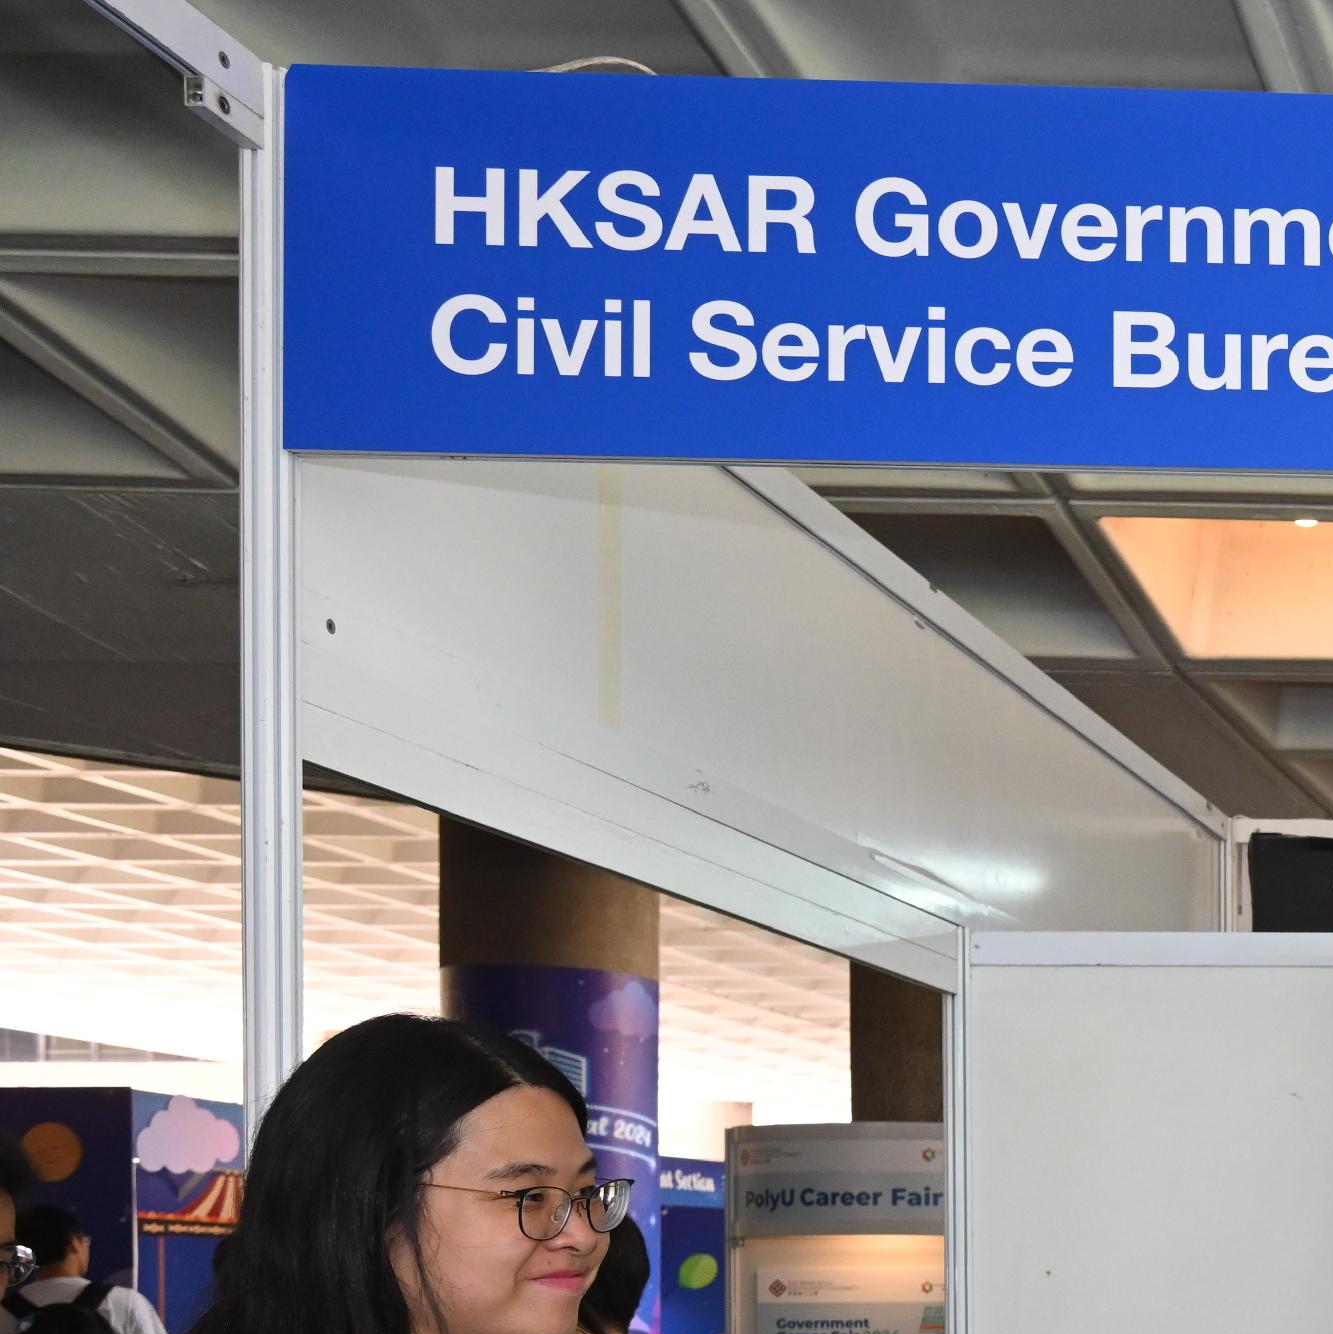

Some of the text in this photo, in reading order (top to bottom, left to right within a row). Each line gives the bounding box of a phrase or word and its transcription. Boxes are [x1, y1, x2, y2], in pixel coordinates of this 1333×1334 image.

[434, 166, 814, 254] HKSAR
[431, 295, 650, 376] Civil
[690, 299, 1072, 387] Service
[745, 1187, 943, 1212] PolyU Career Fair
[776, 1318, 869, 1329] Government
